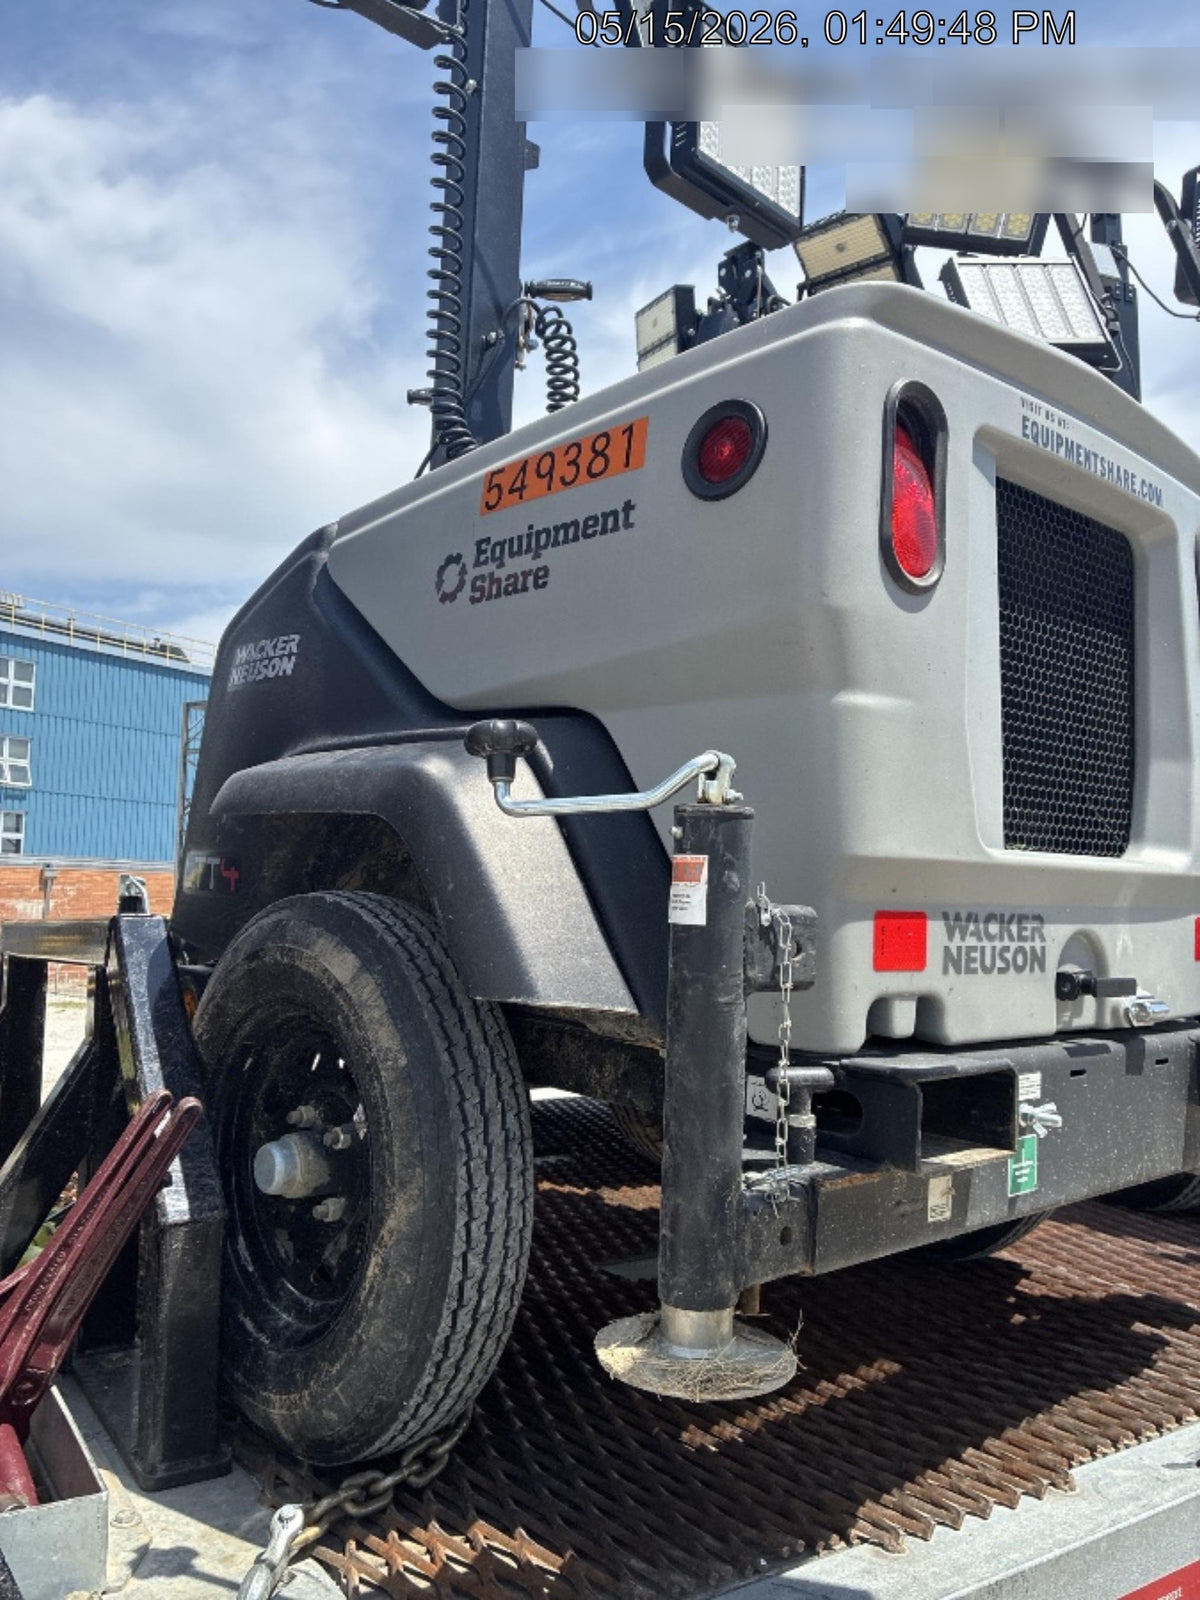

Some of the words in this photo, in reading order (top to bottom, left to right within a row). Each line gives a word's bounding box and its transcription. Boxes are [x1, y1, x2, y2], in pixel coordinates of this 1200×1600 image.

[484, 423, 635, 511] 549381
[1022, 414, 1164, 508] EQUIPMENTSHARE.COM
[473, 499, 636, 569] Equipment
[469, 564, 550, 605] Share
[235, 634, 300, 665] WACKER
[228, 656, 296, 687] NEUSON
[941, 911, 1046, 943] WACKER
[942, 944, 1046, 975] NEUSON
